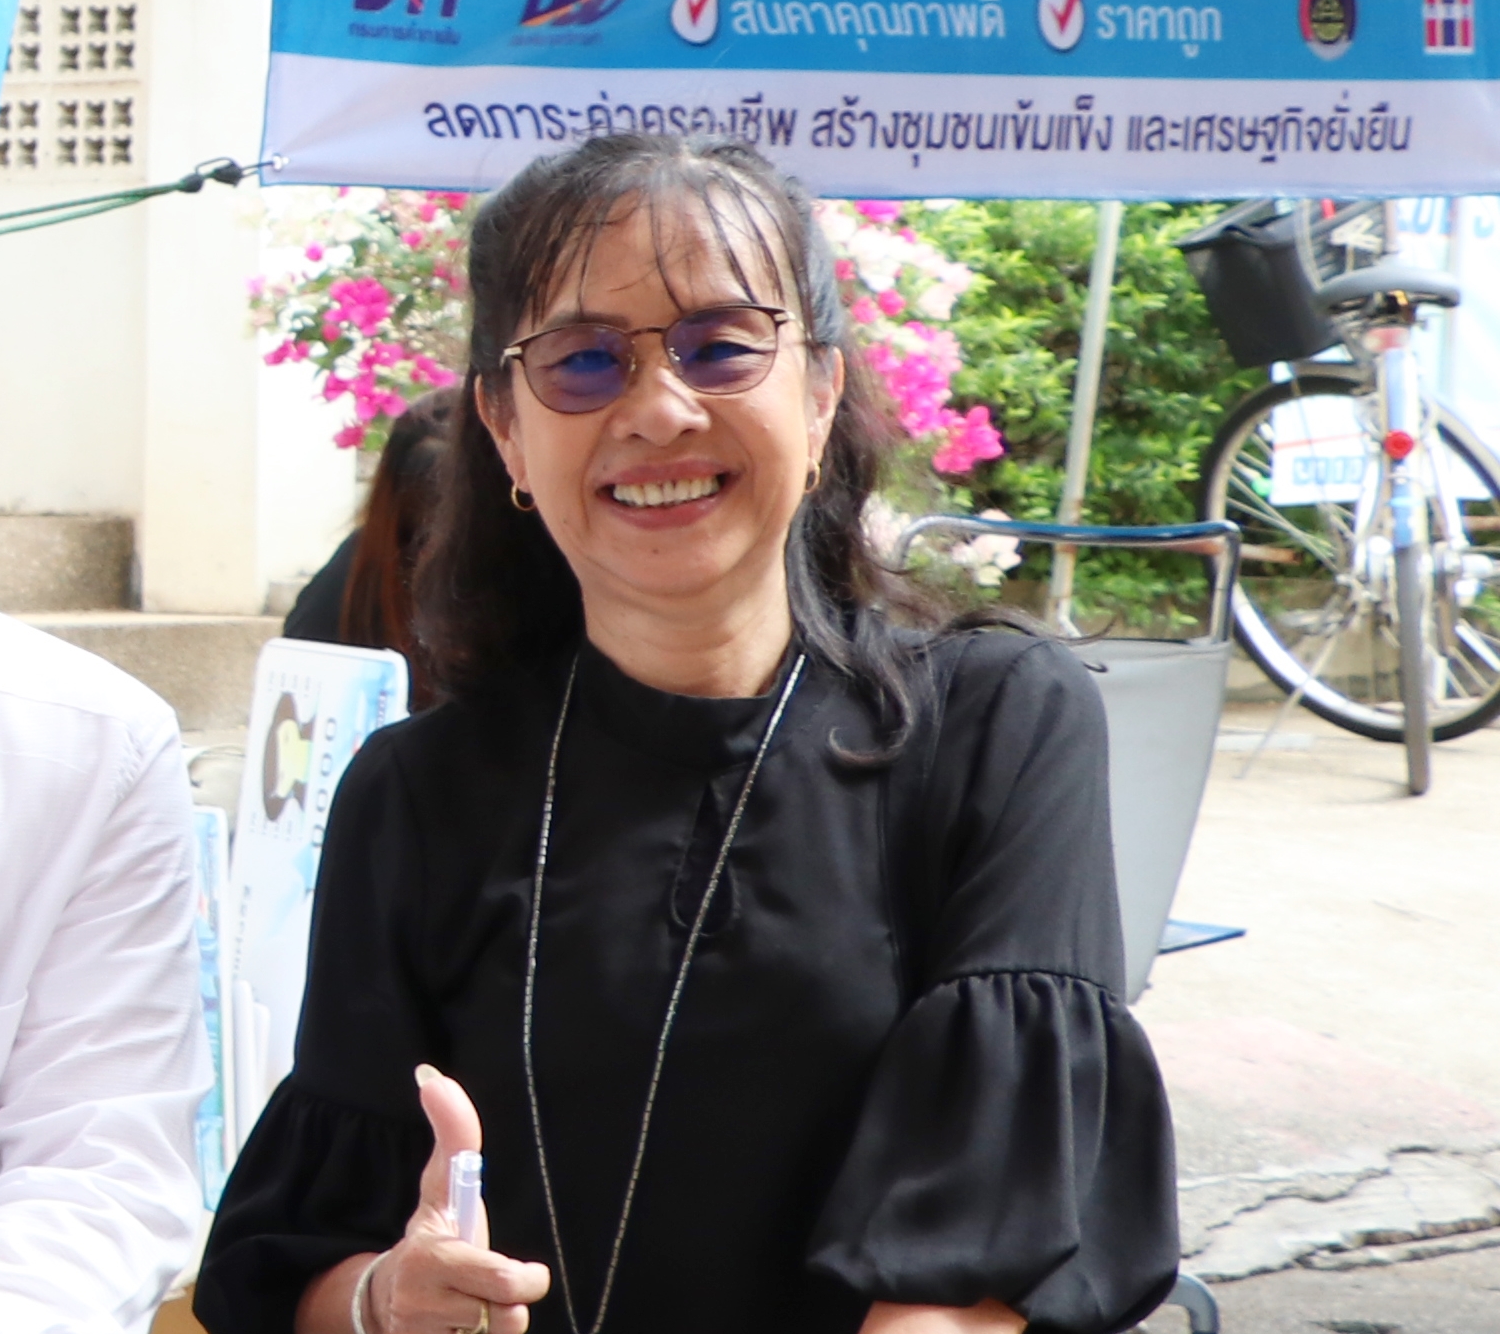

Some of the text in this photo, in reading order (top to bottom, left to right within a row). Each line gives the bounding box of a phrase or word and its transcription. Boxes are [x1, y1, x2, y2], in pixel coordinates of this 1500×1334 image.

[809, 94, 1113, 164] สร้างชุมชนเข้มแข็ง
[1126, 90, 1411, 163] และเศรษฐกิจยั่งยืน
